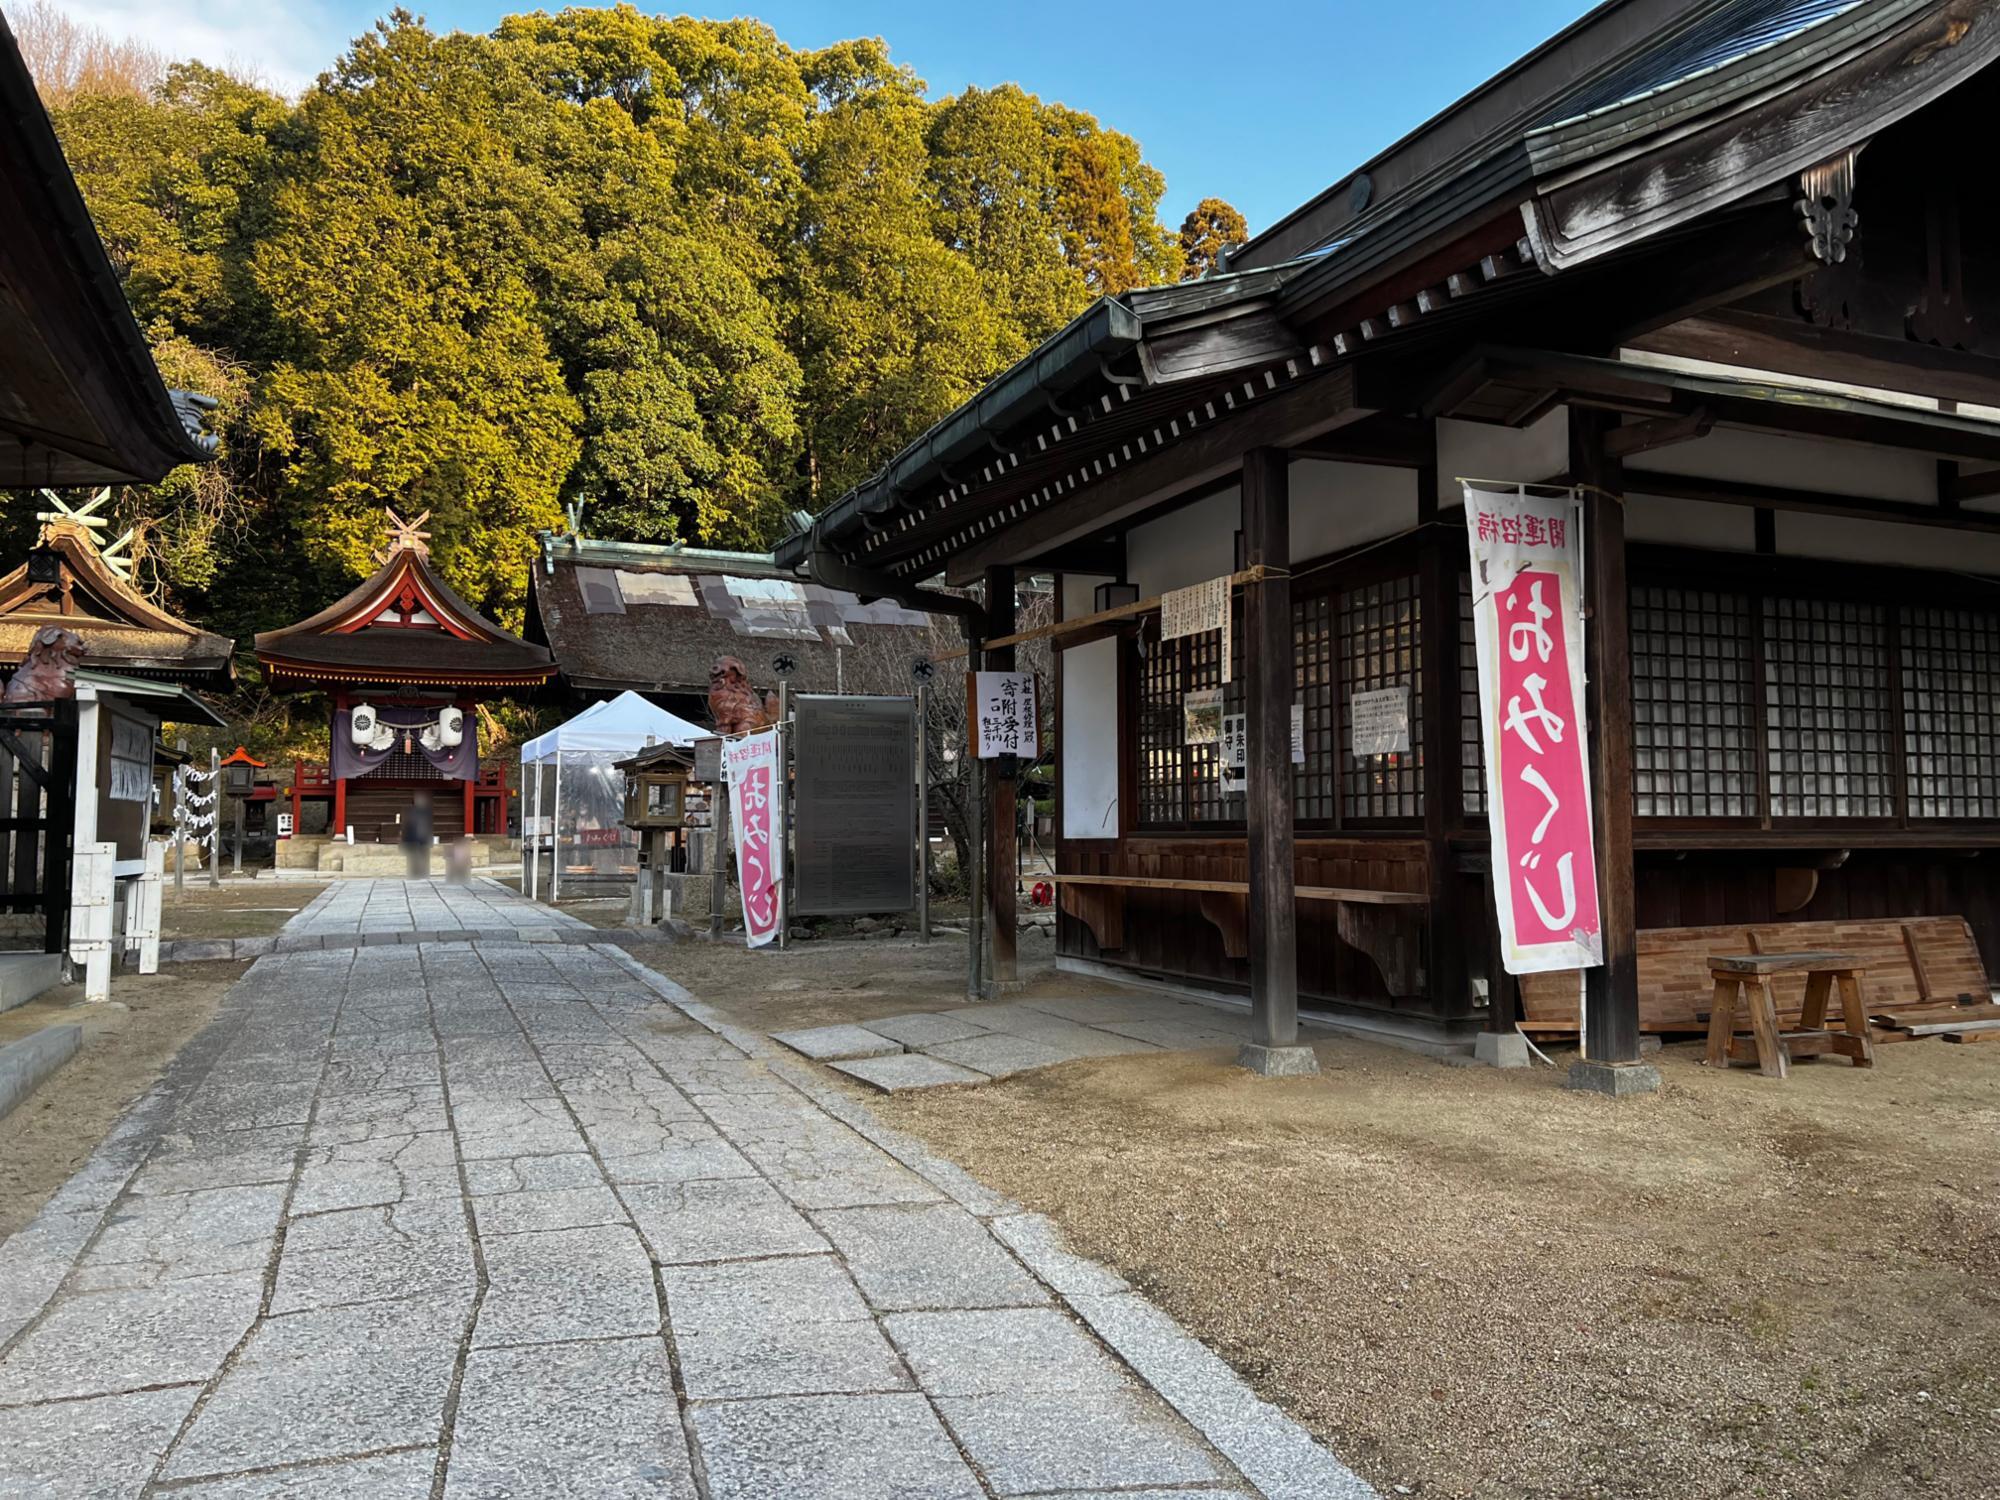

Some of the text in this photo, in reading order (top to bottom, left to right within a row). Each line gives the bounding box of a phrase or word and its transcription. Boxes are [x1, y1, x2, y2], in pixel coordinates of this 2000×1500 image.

[1001, 678, 1020, 750] 寄附受付
[1224, 719, 1233, 751] 御守
[1236, 718, 1245, 763] 御朱印
